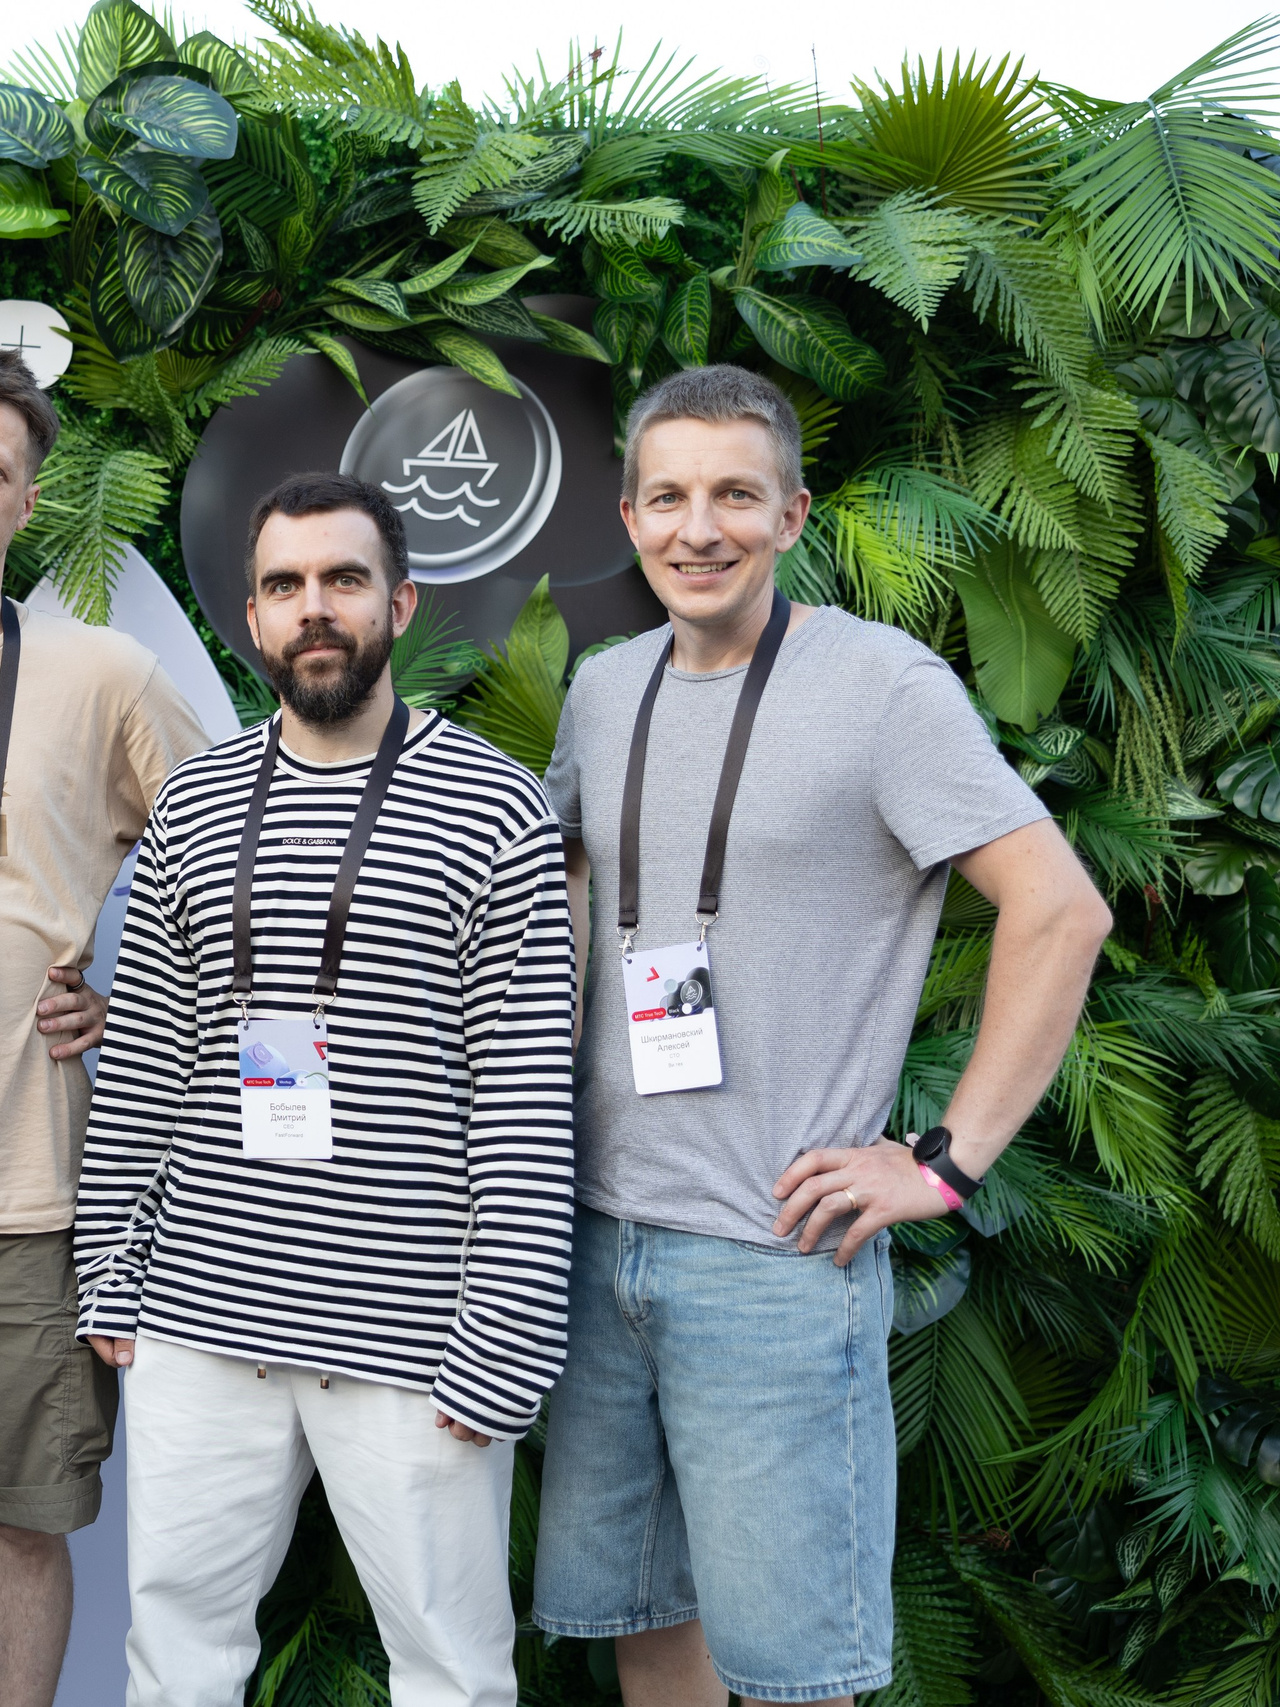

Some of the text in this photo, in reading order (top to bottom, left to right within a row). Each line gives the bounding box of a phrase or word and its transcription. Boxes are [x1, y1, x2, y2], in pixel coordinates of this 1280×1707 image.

[282, 837, 302, 845] DOLCE
[640, 1028, 704, 1044] Шкирмановский
[657, 1040, 690, 1052] Алексей
[269, 1102, 307, 1111] Бобылев
[270, 1113, 307, 1123] Дмитрий
